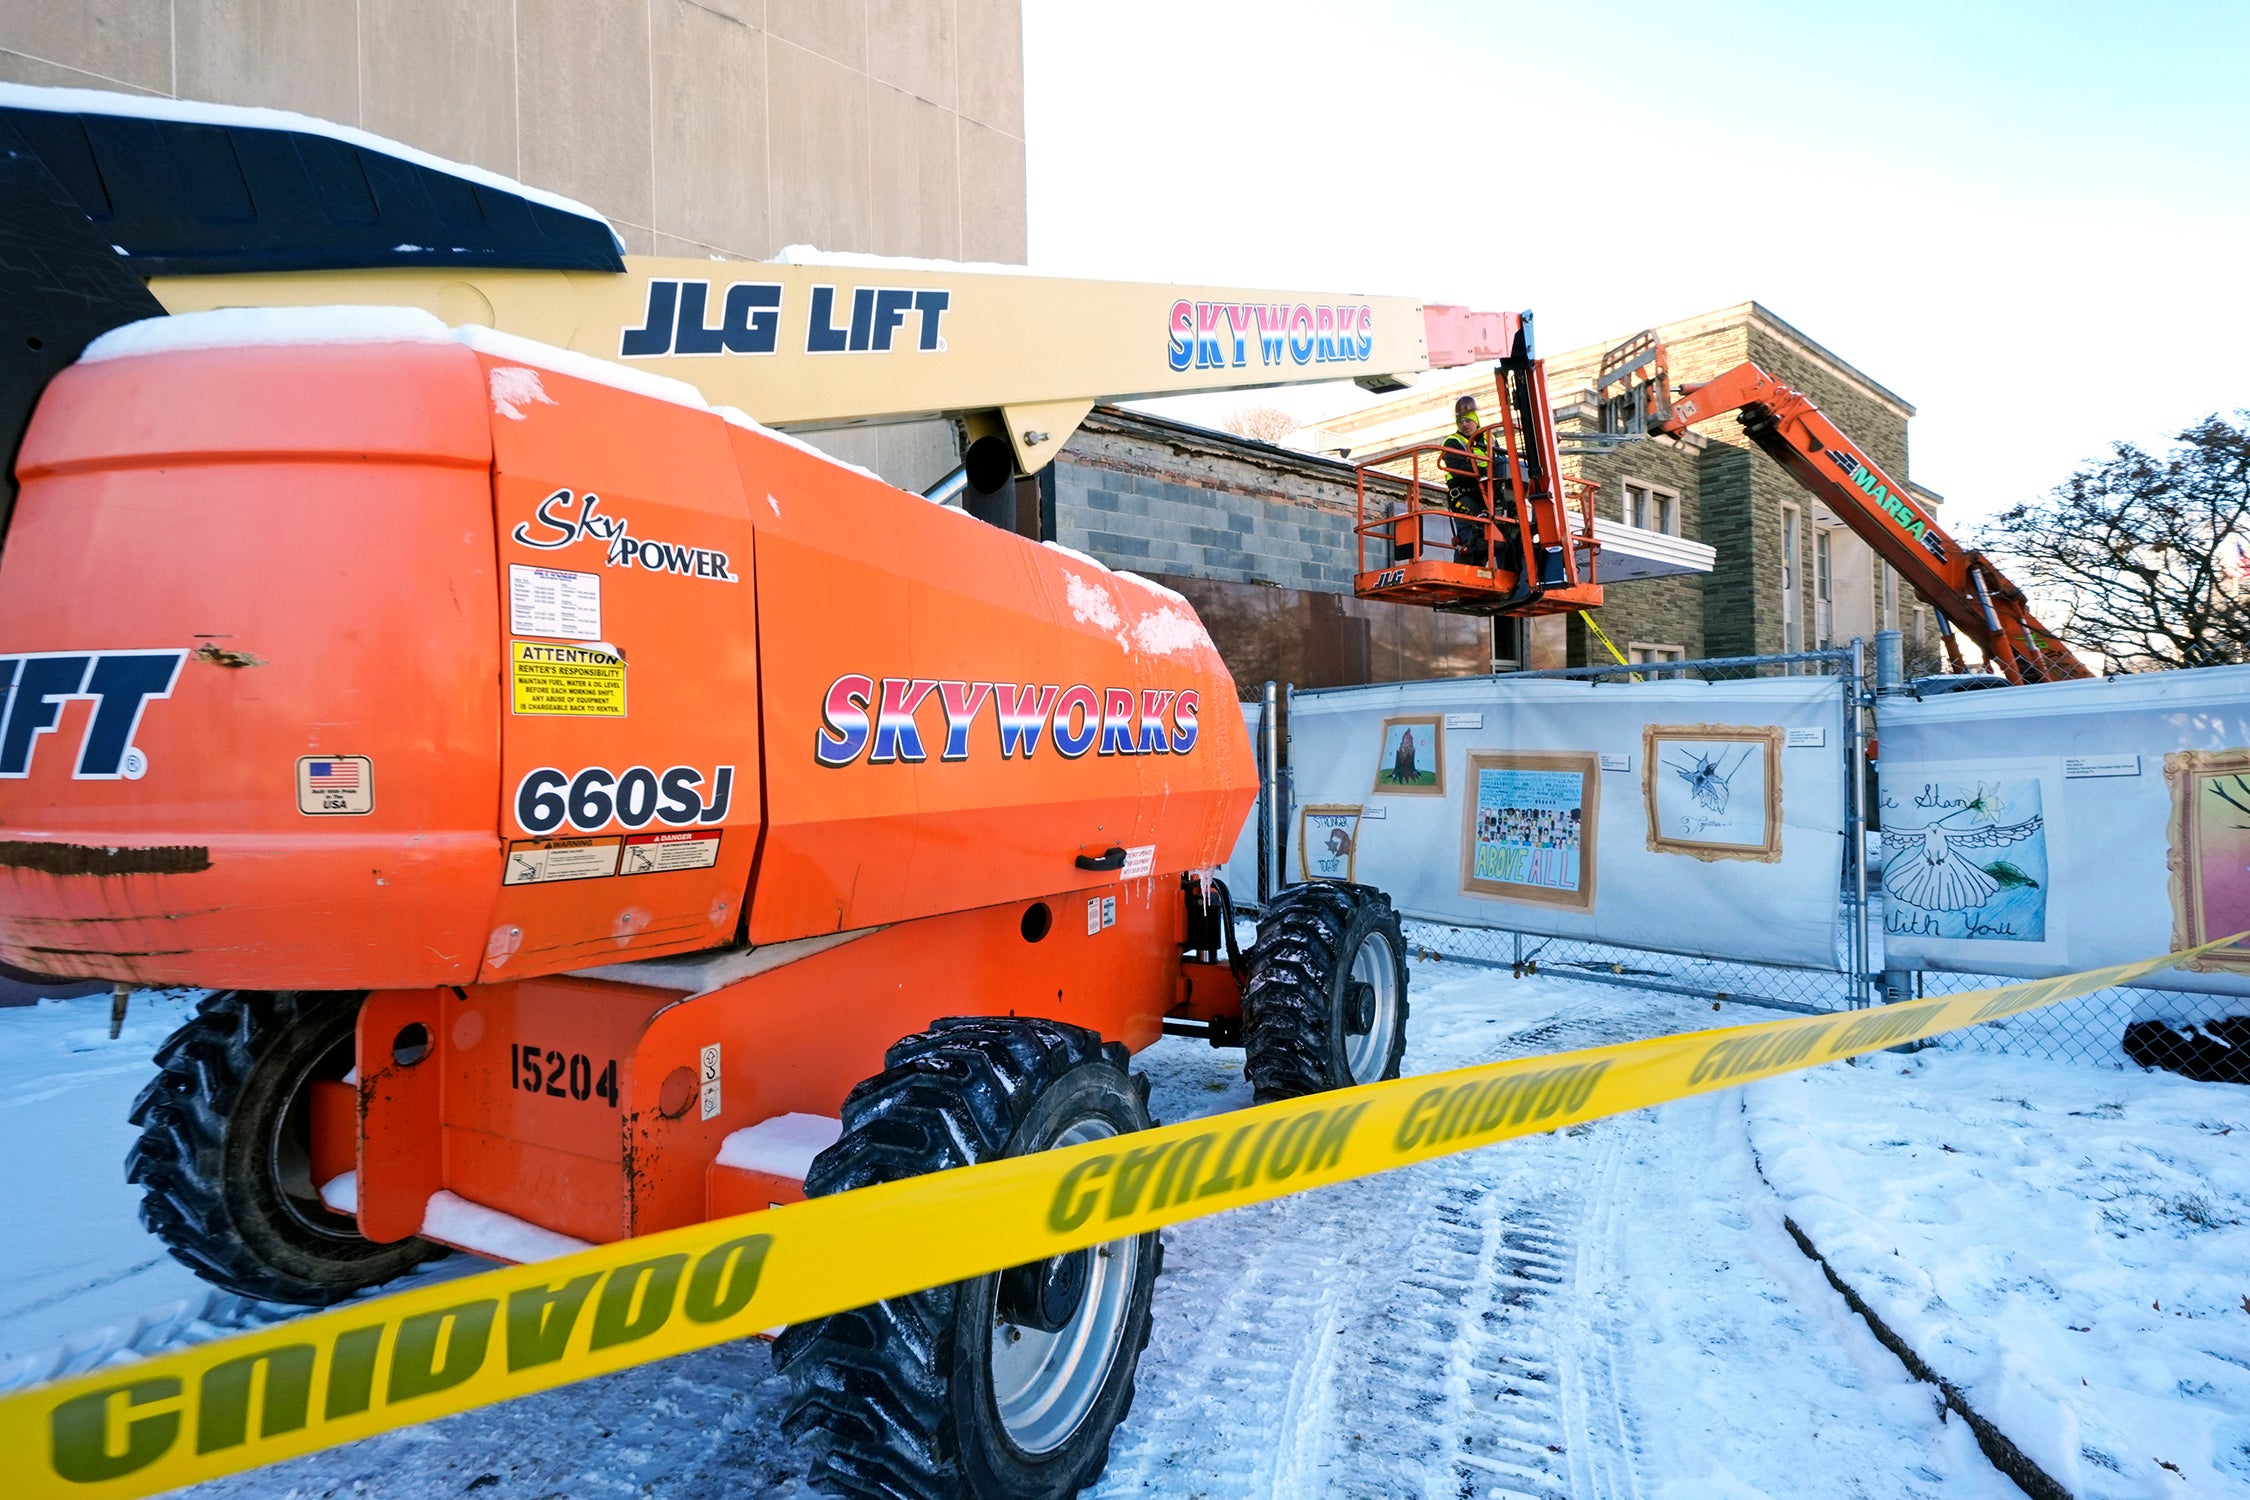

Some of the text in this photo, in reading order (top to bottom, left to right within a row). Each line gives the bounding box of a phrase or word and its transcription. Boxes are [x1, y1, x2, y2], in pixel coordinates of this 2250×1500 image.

[619, 277, 951, 358] JLG LIFT
[1167, 298, 1373, 373] SKYWORKS
[1851, 465, 1926, 542] MARSA
[1373, 568, 1406, 589] JLG
[522, 646, 619, 665] ATTENTION
[518, 664, 620, 678] RENTER'S RESPONSIBILITY
[566, 680, 586, 688] WATER
[604, 681, 620, 689] LEVEL
[525, 686, 549, 694] BEFORE
[569, 688, 596, 696] WORKING
[0, 648, 191, 780] FT
[815, 673, 1201, 768] SKYWORKS
[323, 800, 347, 809] USA
[514, 765, 734, 835] 660SJ
[553, 839, 593, 849] WARNING
[661, 833, 693, 842] DANGER
[1475, 844, 1576, 888] ABOVE ALL
[1962, 911, 2017, 940] You
[511, 1043, 619, 1108] 15204
